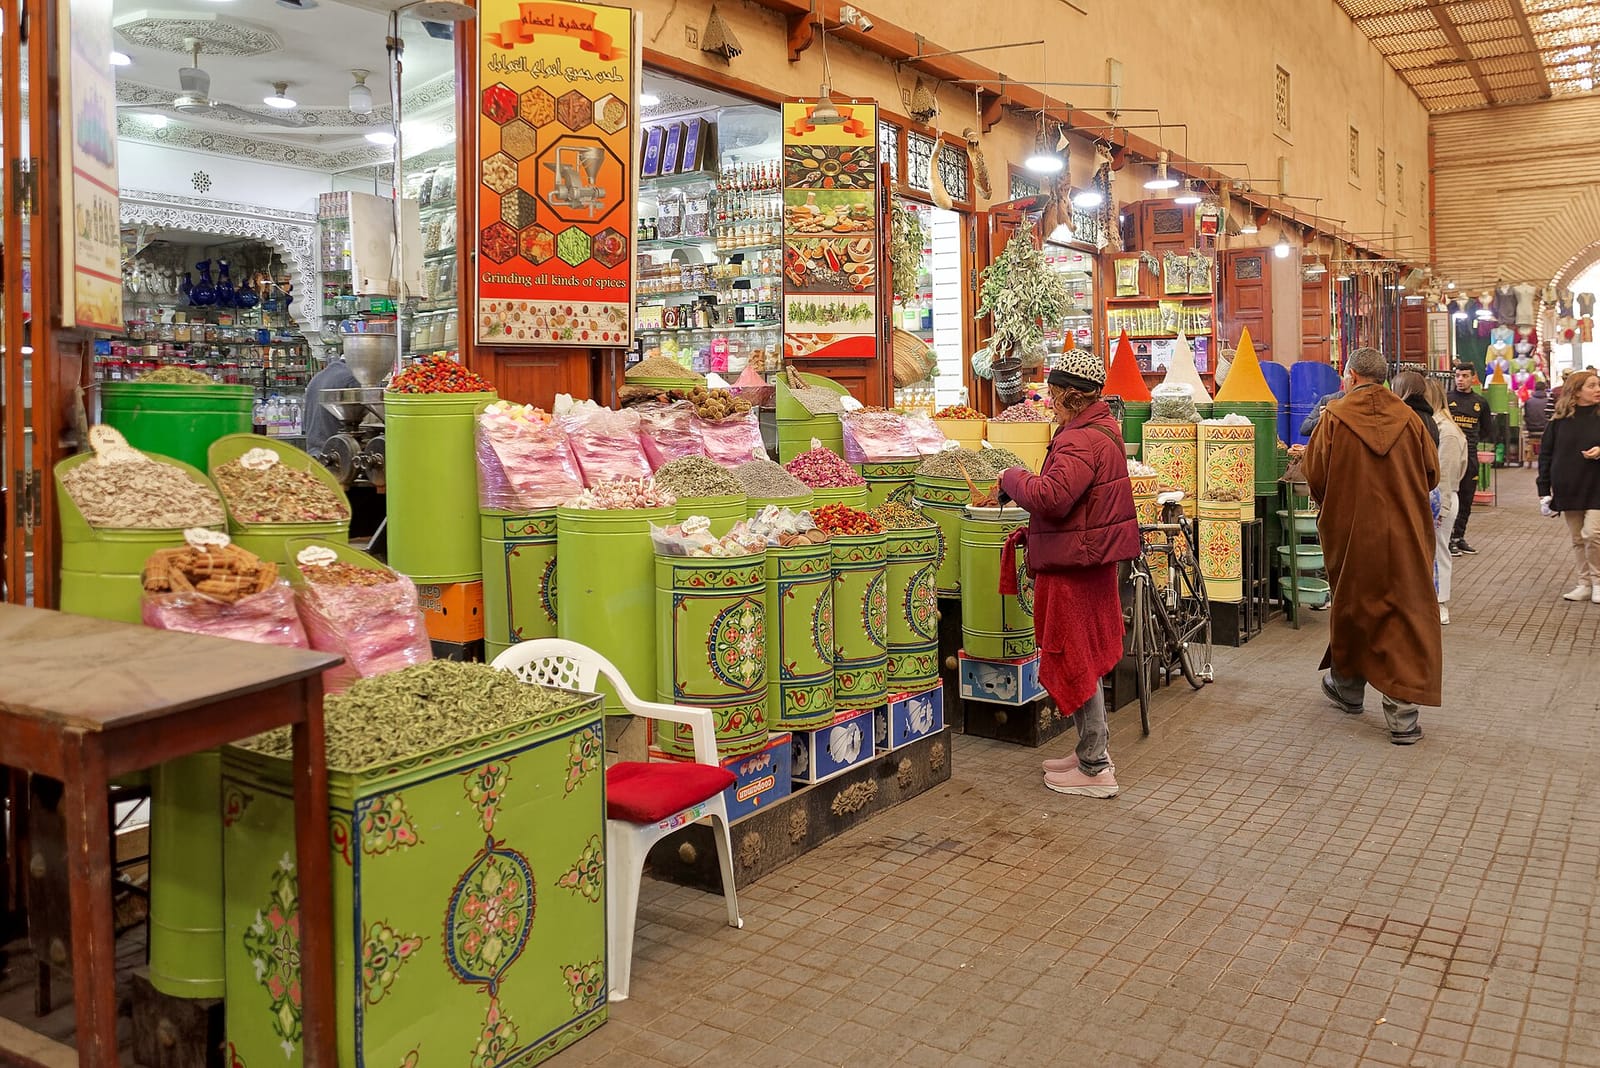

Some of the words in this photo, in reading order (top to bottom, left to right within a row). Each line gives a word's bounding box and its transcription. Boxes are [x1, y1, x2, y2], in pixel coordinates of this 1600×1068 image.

[487, 53, 529, 74] التوابل
[564, 67, 594, 83] جميع
[594, 66, 624, 84] طحن
[482, 272, 532, 287] Grinding
[534, 273, 548, 285] all
[551, 274, 580, 286] kinds
[582, 275, 594, 286] of
[595, 277, 626, 290] spices
